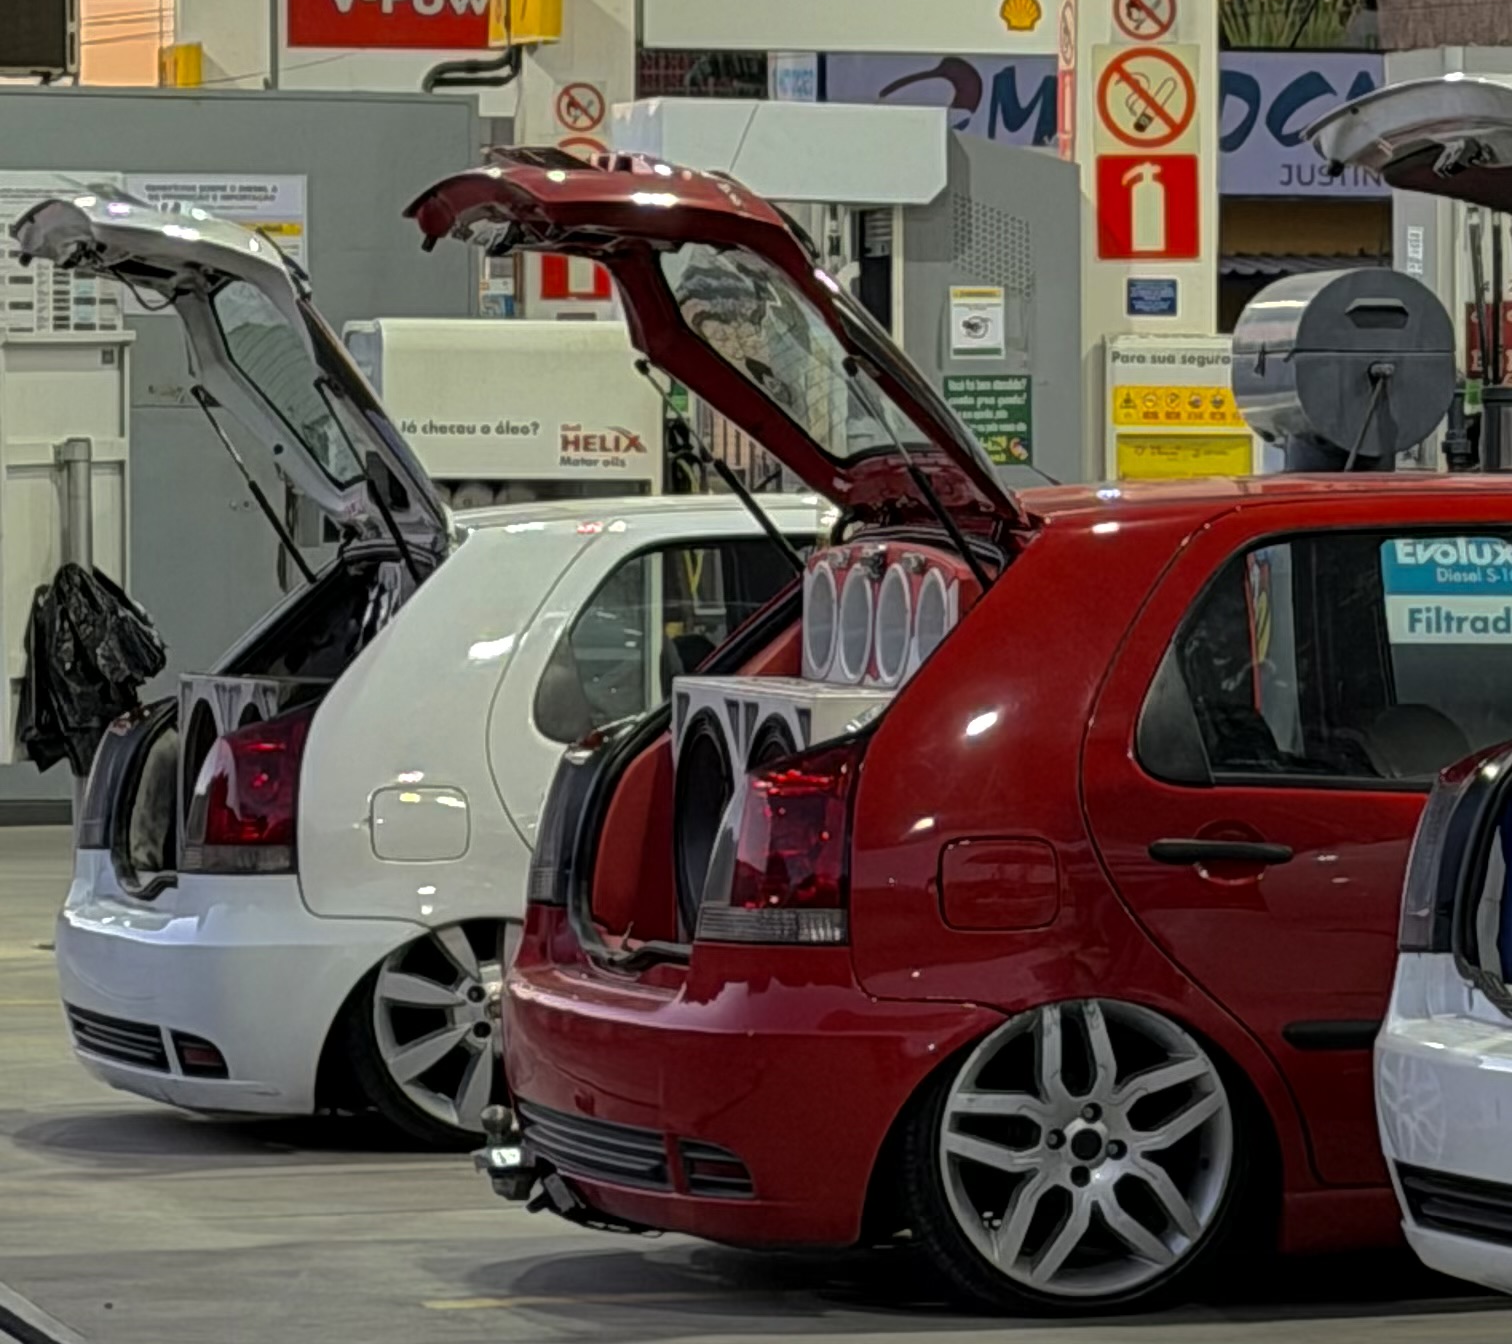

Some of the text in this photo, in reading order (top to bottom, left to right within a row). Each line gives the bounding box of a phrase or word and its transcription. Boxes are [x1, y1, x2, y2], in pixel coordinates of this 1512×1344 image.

[1111, 351, 1146, 365] Para
[1149, 352, 1177, 365] sua
[560, 433, 648, 454] HELIX
[1435, 568, 1482, 584] Diesel
